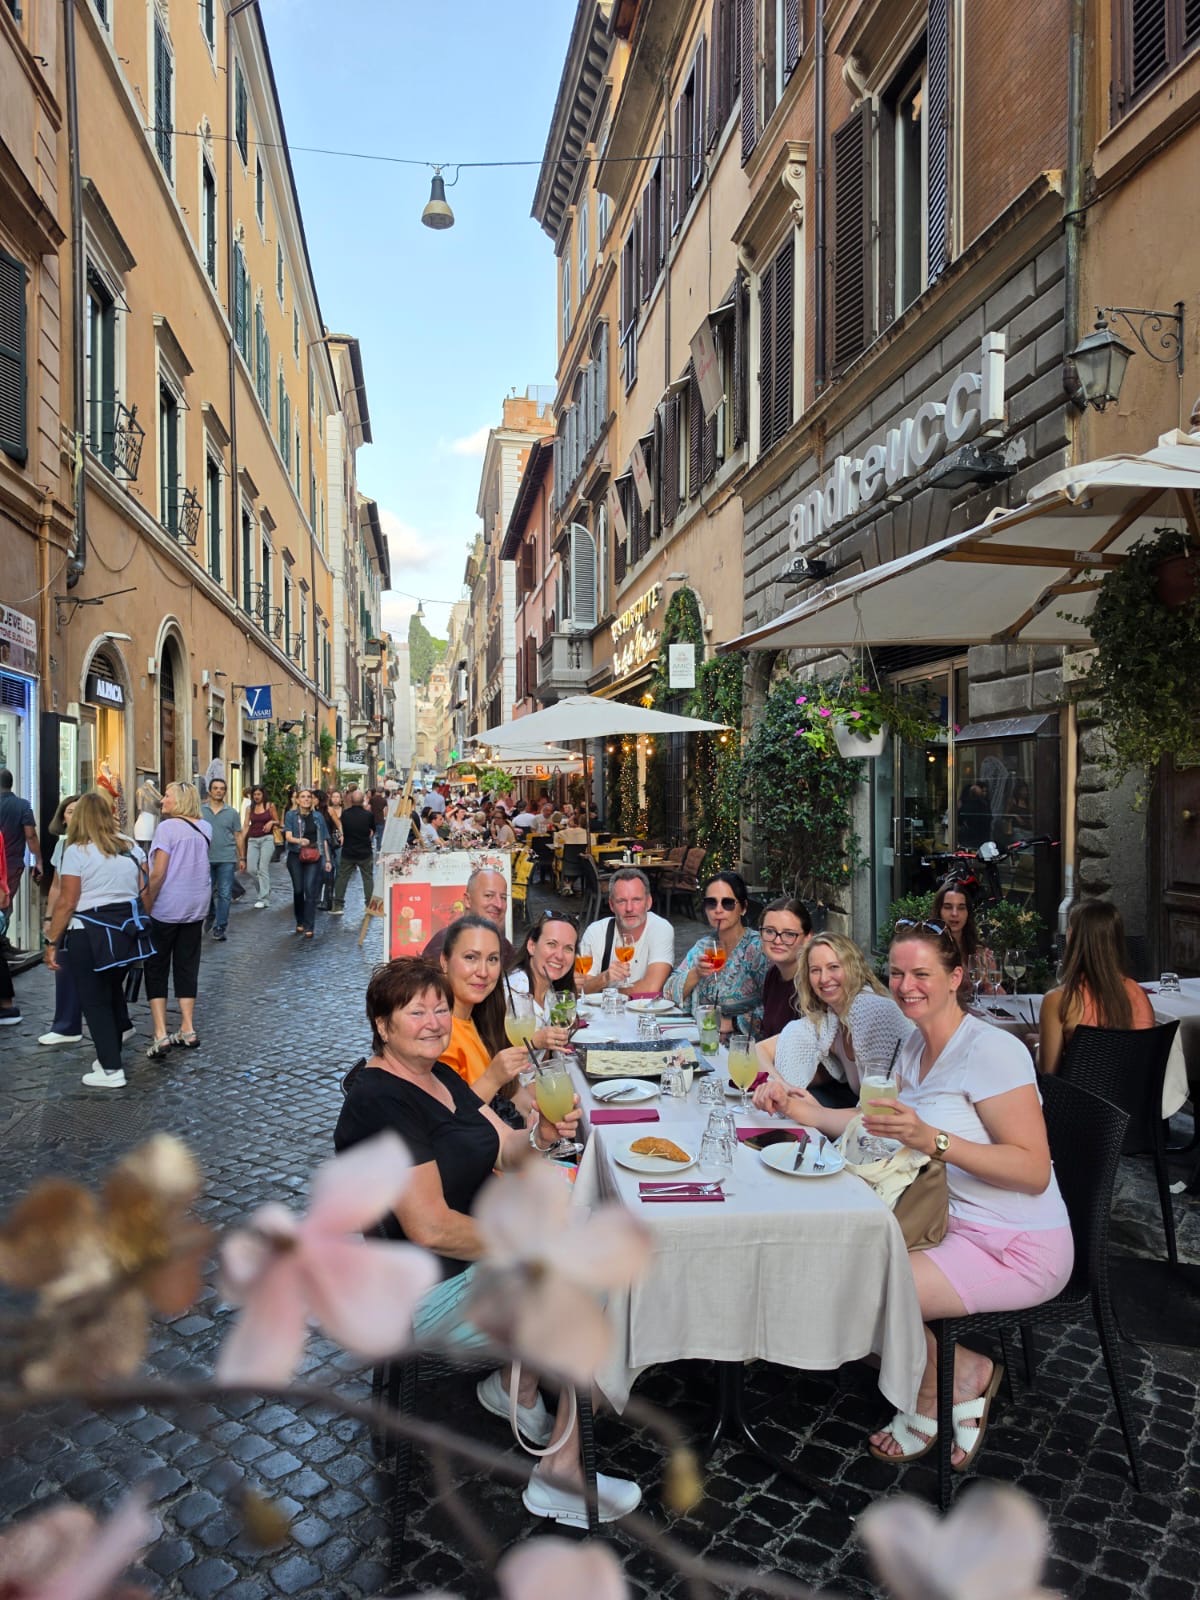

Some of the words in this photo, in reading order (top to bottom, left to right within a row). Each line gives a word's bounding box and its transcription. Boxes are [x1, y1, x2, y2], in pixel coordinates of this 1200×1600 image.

[789, 331, 1005, 551] andreucci
[245, 688, 271, 717] VASARI
[499, 764, 562, 775] ZZERIA
